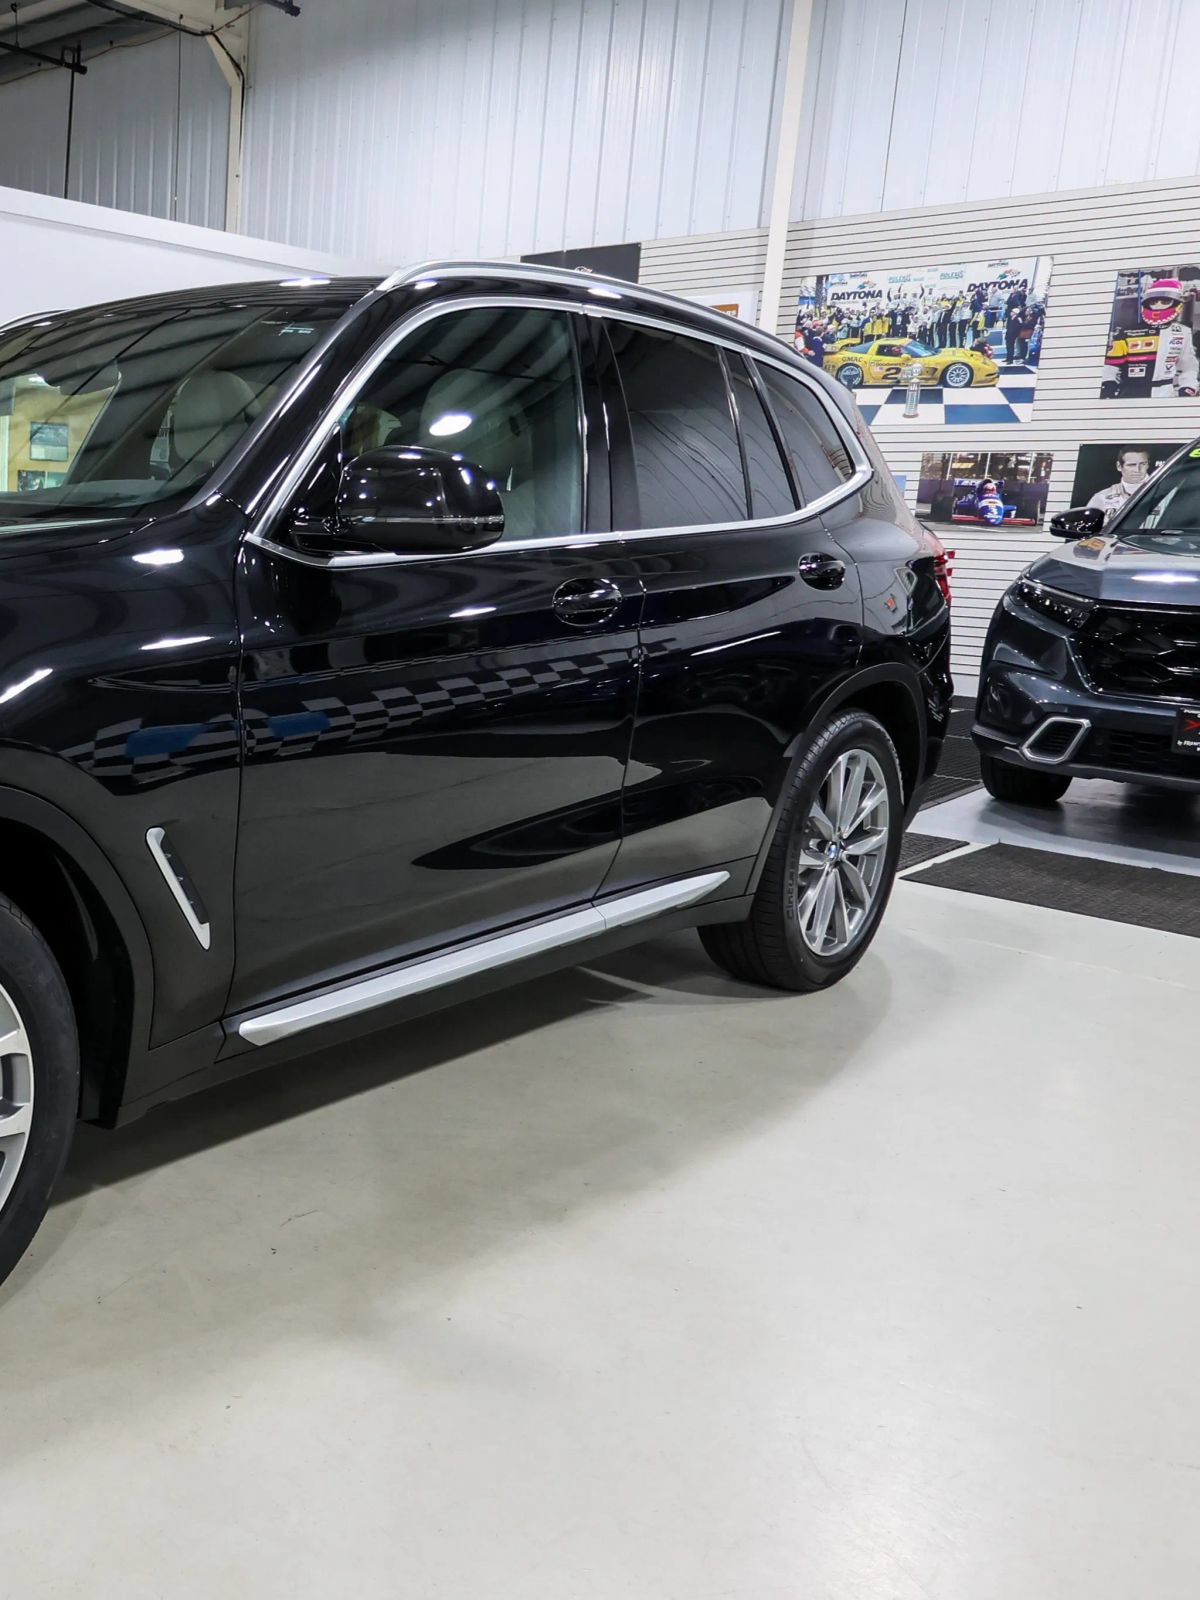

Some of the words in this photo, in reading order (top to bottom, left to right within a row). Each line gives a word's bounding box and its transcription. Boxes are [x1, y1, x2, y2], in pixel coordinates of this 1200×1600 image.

[967, 278, 1029, 293] DAYTONA
[830, 289, 883, 301] DAYTONA
[882, 367, 901, 380] 2
